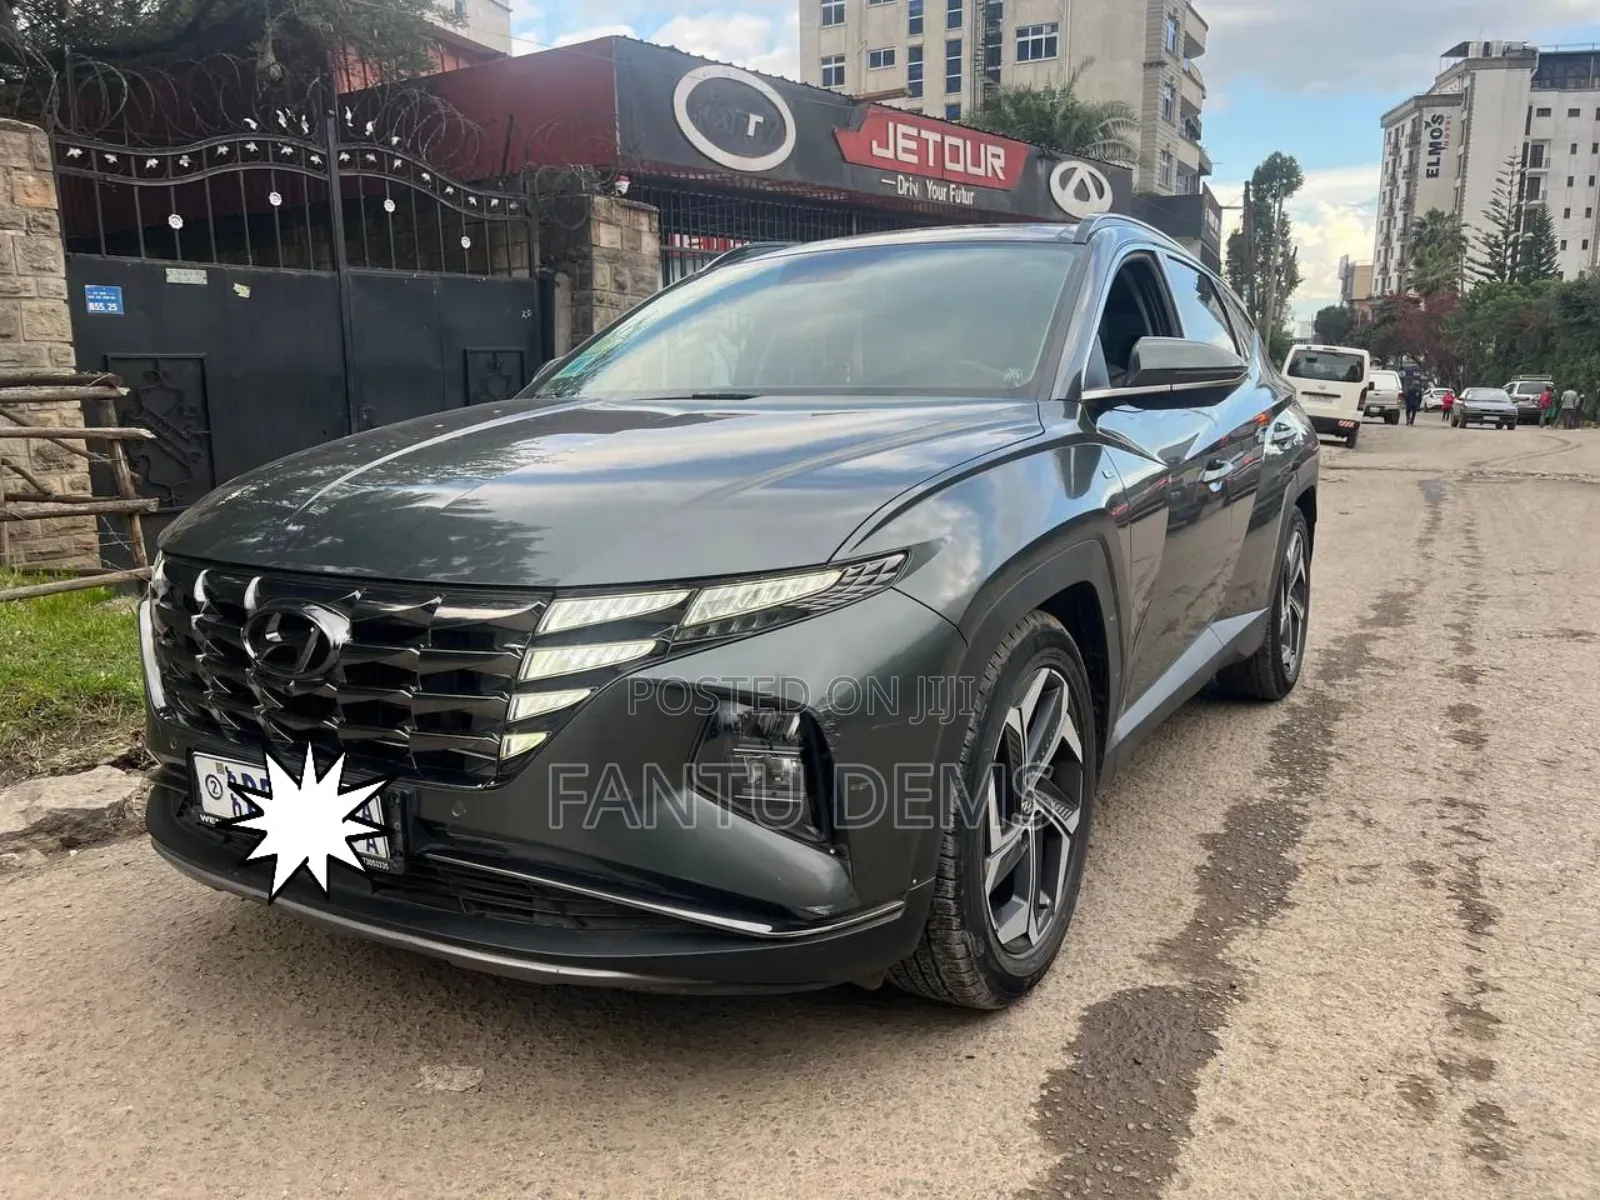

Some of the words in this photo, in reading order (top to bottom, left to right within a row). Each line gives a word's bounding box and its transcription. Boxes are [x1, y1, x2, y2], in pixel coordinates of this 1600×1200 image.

[871, 121, 1006, 180] JETOUR
[926, 179, 947, 202] Your
[949, 184, 975, 205] Futur
